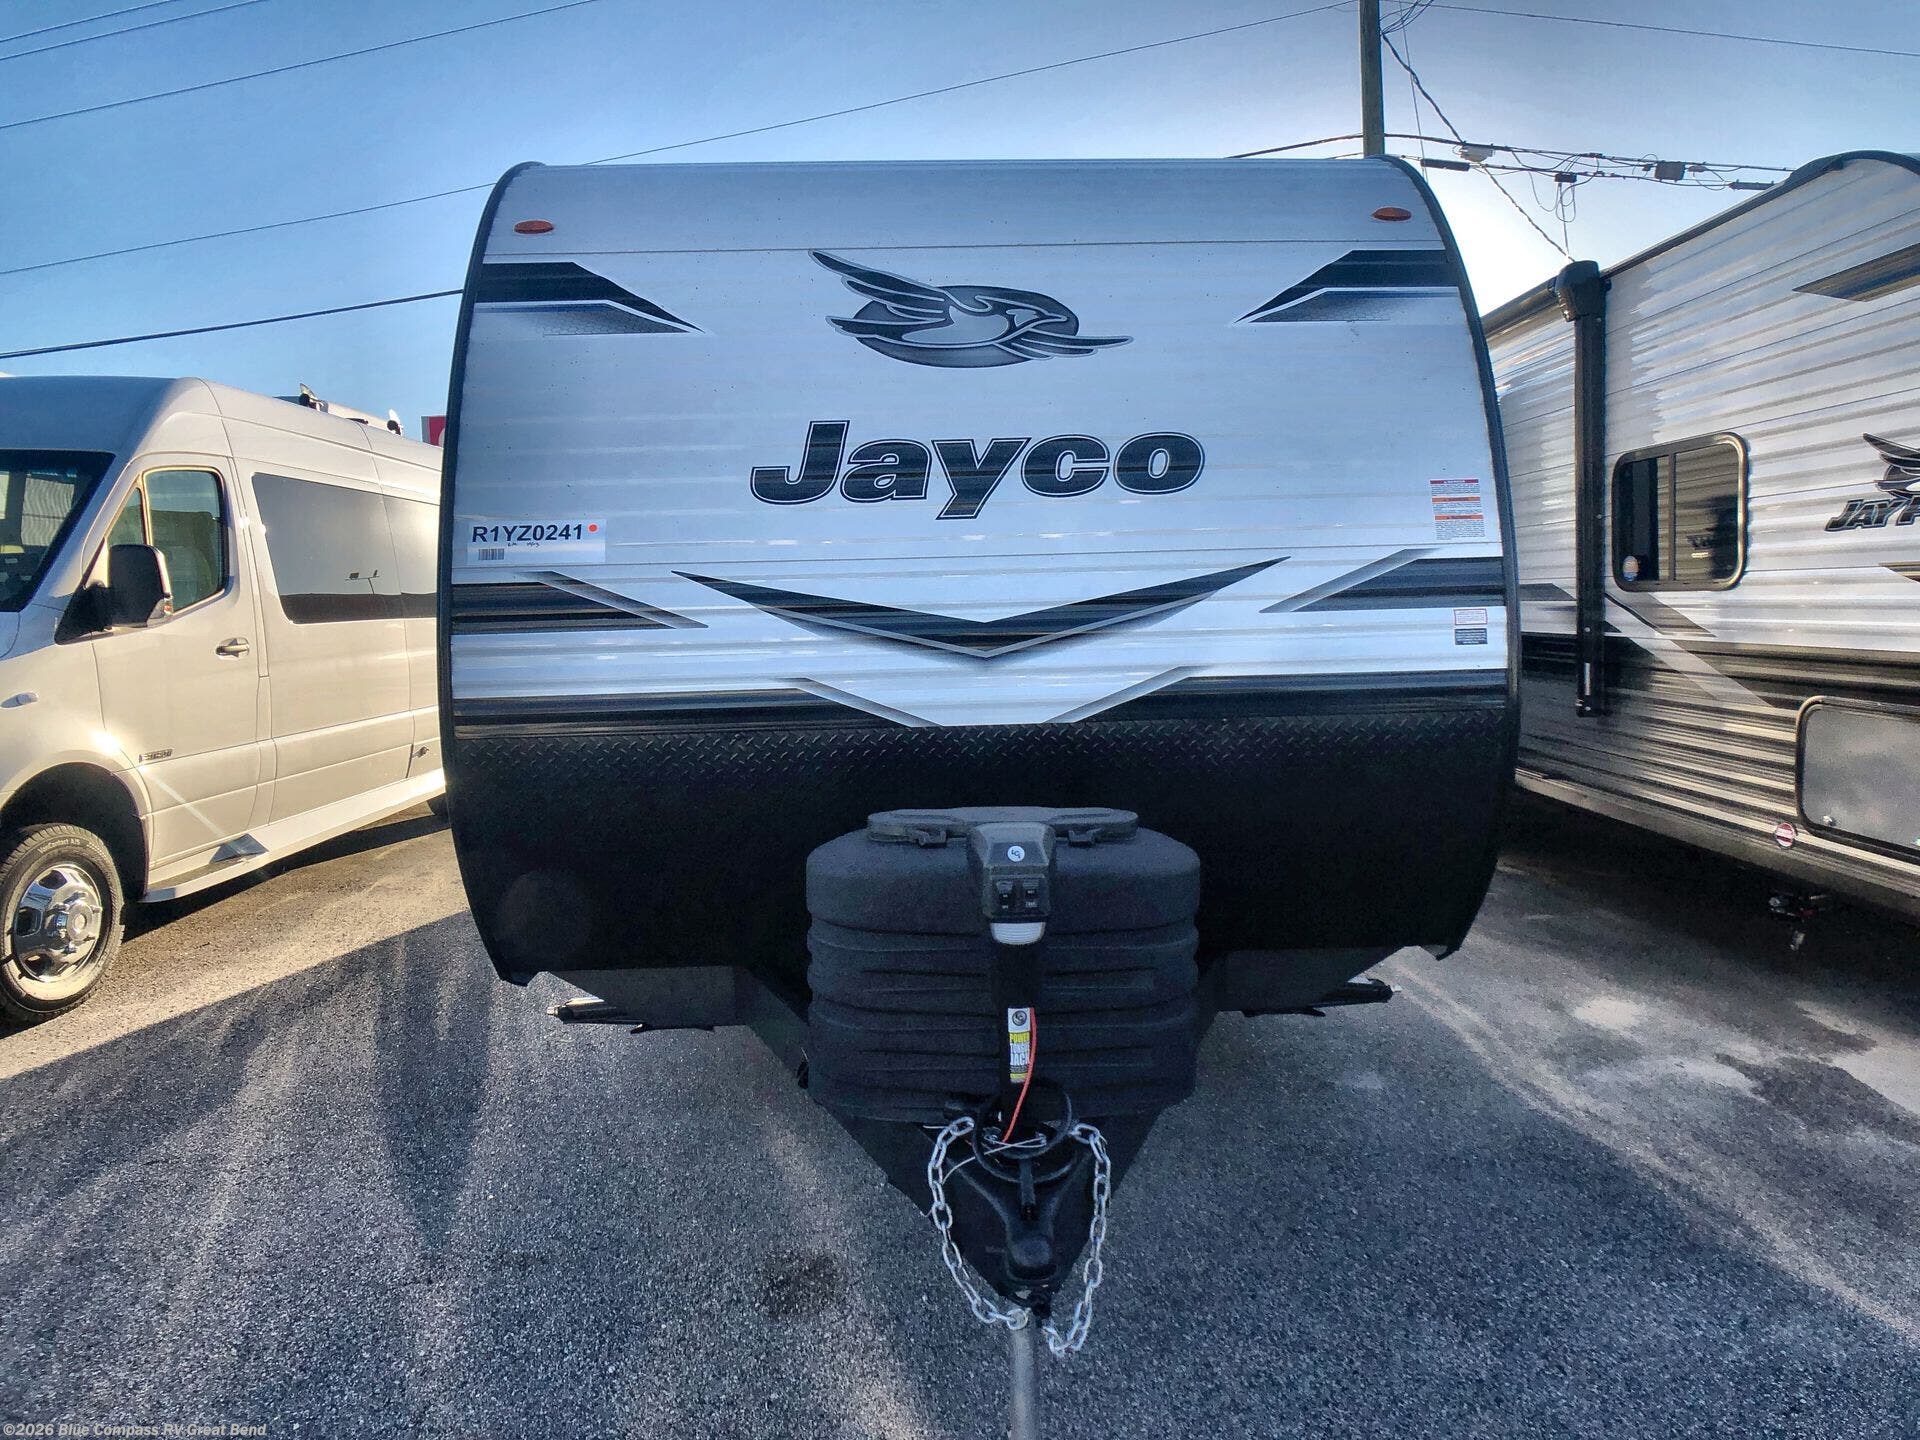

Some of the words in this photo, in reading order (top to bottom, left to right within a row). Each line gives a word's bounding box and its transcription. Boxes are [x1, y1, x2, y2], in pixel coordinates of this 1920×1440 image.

[750, 419, 1206, 520] Jayco
[1824, 497, 1908, 531] JAY
[472, 524, 582, 542] R1YZ0241
